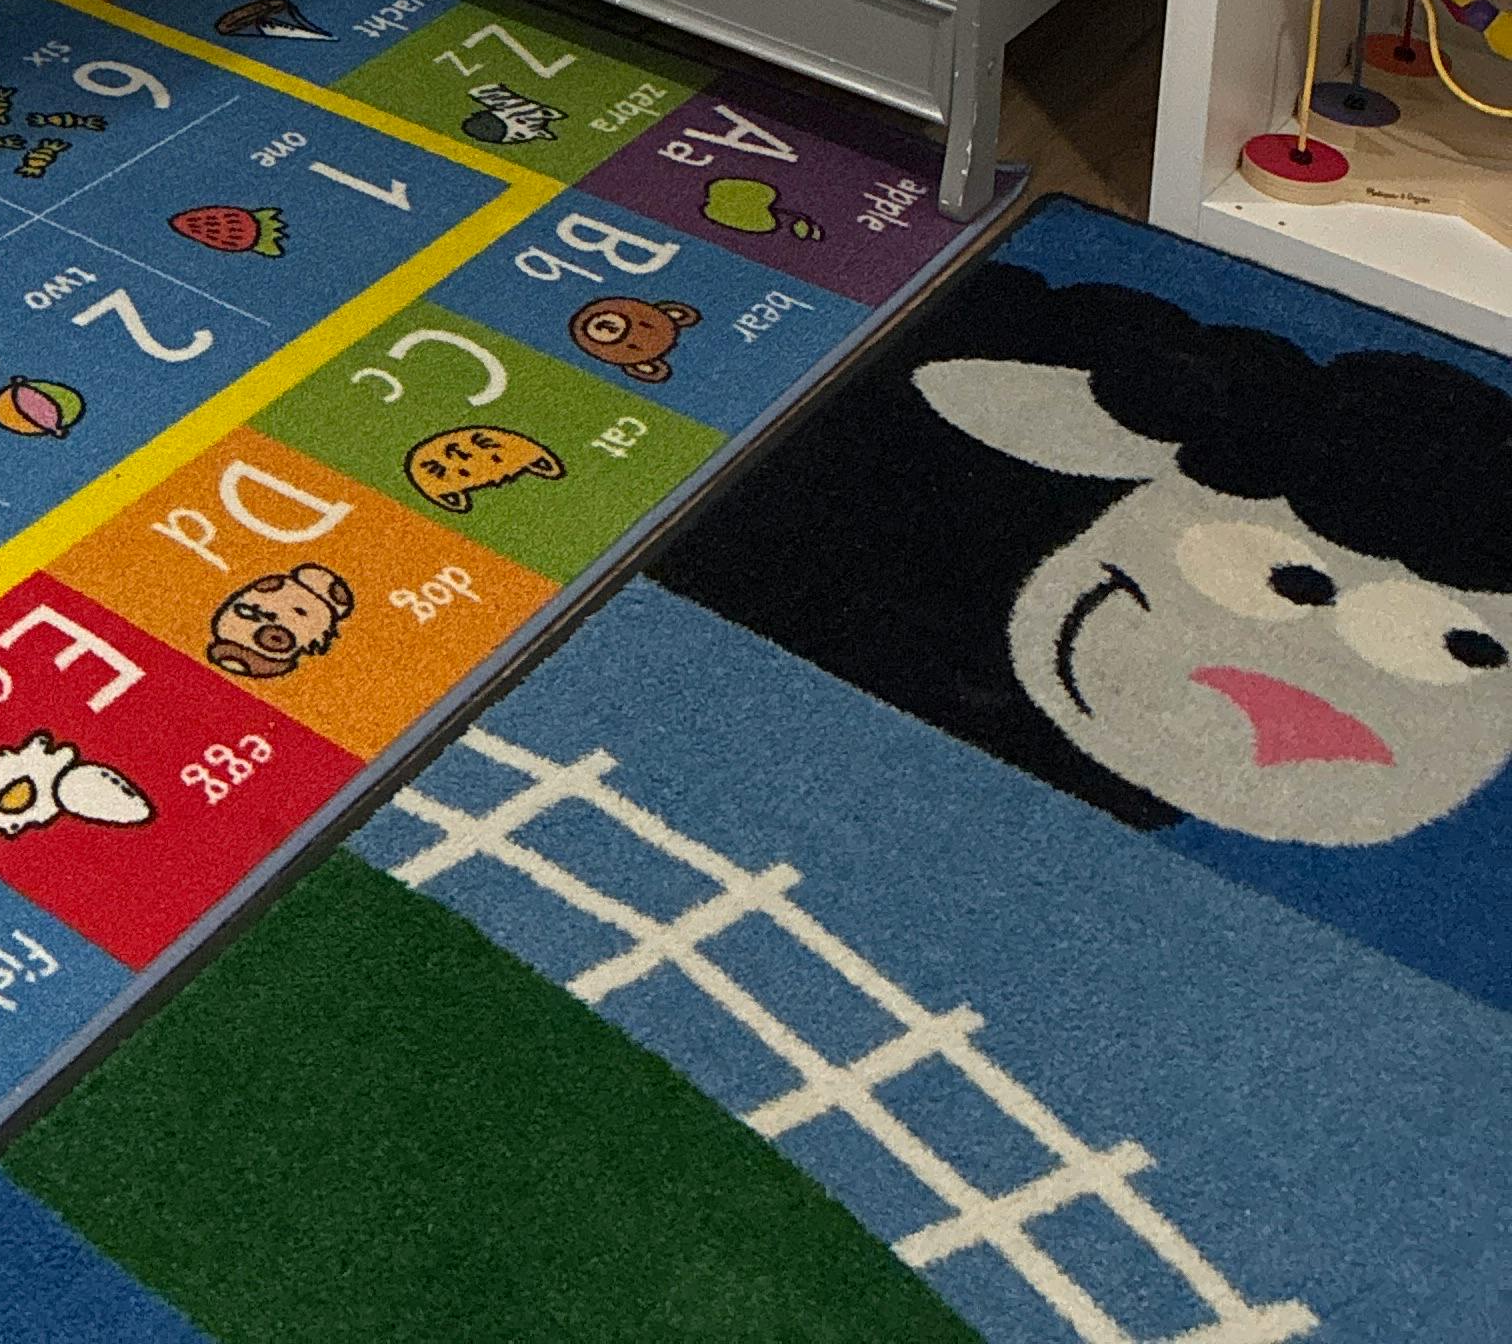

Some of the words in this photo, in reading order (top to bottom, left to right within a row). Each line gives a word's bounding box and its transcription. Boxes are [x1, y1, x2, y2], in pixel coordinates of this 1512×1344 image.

[23, 40, 73, 69] six
[74, 62, 170, 109] 6
[590, 84, 665, 132] zebra
[251, 131, 307, 168] one
[310, 163, 410, 210] 1
[857, 180, 925, 231] apple
[24, 265, 99, 312] two
[71, 287, 214, 362] 2
[734, 291, 812, 342] bear
[592, 417, 646, 457] cat
[389, 567, 479, 623] dog
[181, 736, 271, 804] egg
